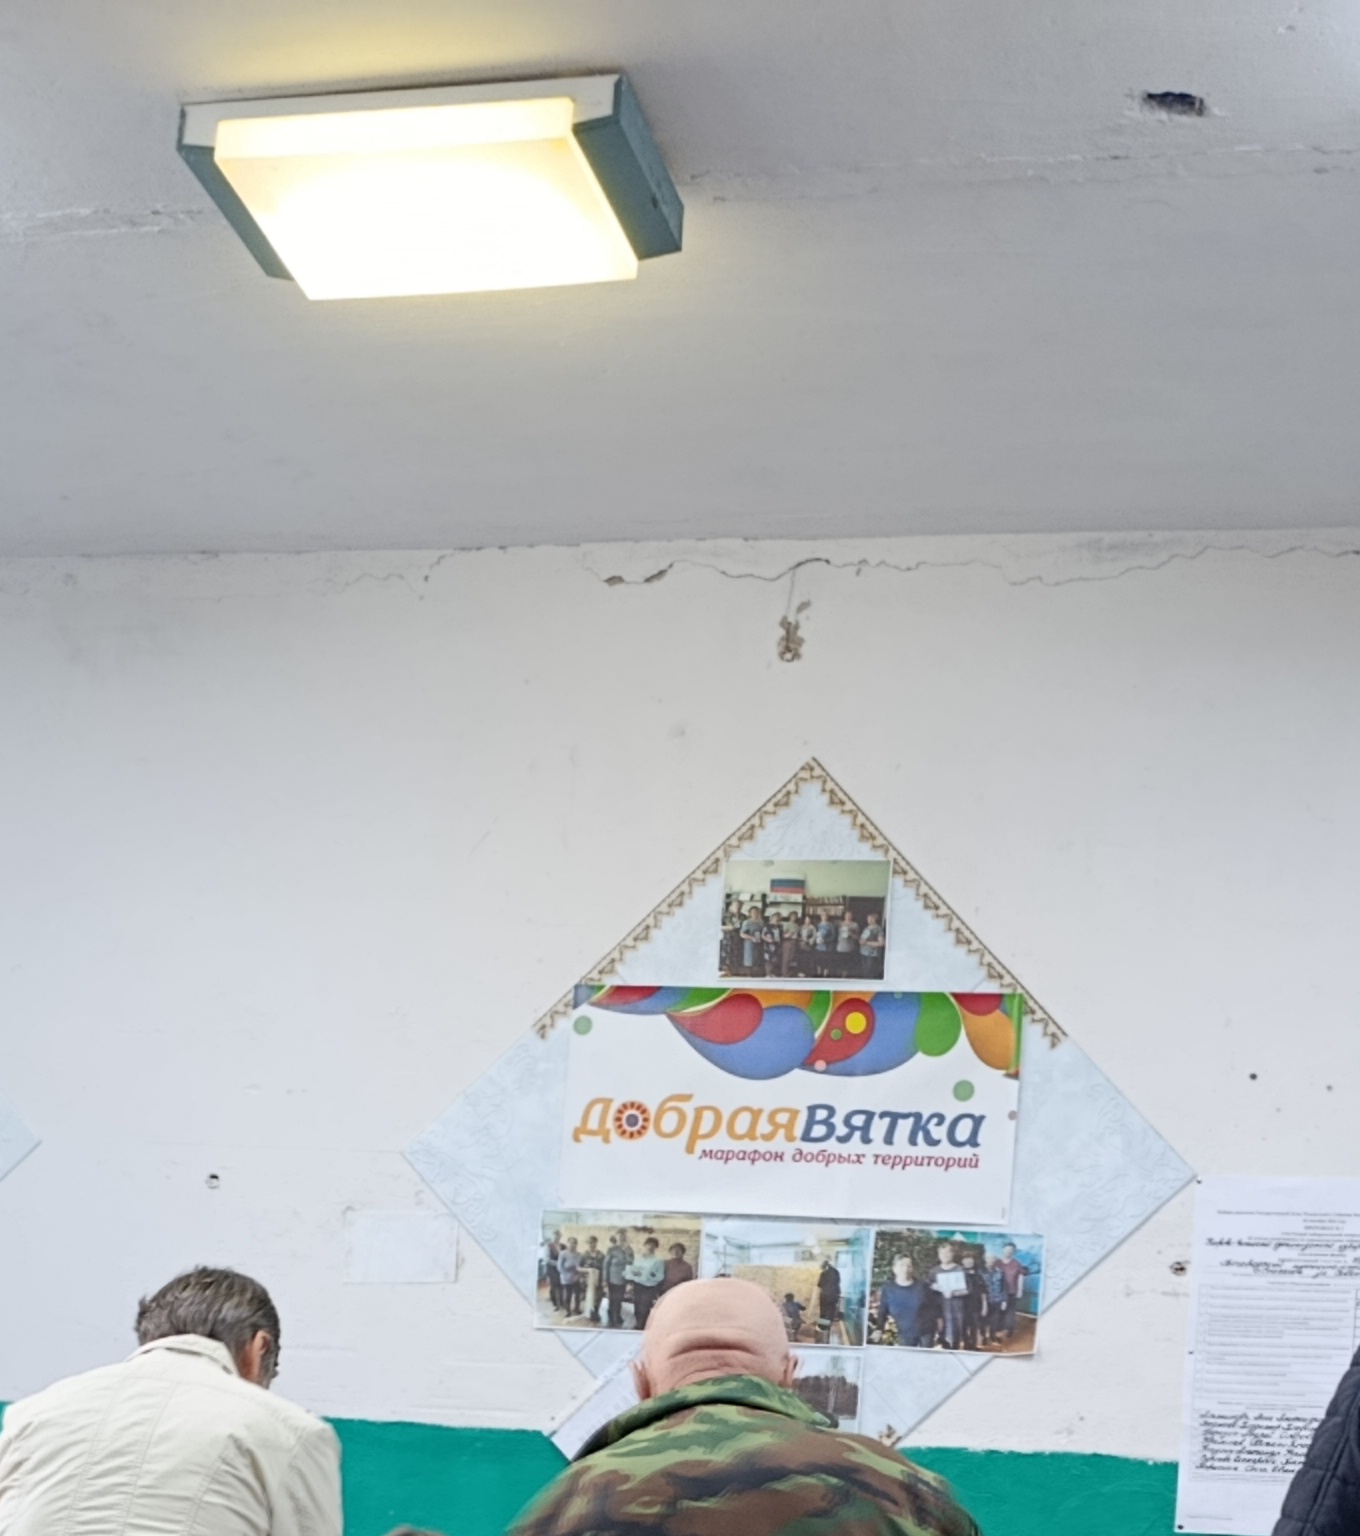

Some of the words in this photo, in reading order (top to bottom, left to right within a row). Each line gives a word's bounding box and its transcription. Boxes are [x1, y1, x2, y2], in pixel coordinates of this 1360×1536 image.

[698, 1146, 786, 1166] марафон
[791, 1148, 867, 1167] добрых
[872, 1151, 982, 1172] территорий
